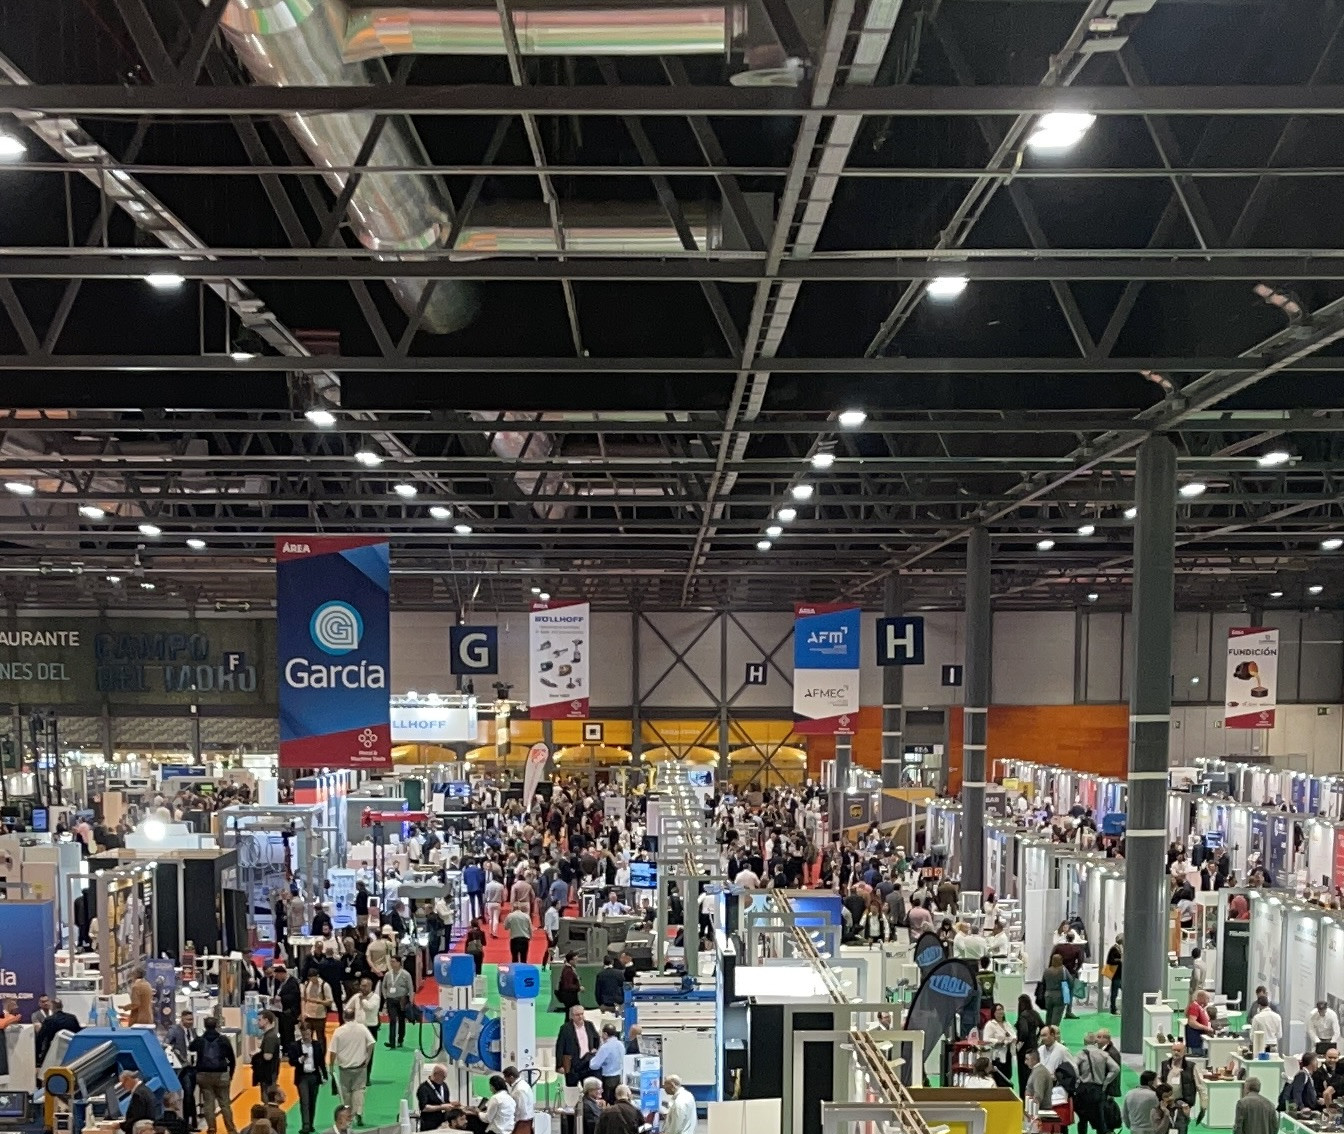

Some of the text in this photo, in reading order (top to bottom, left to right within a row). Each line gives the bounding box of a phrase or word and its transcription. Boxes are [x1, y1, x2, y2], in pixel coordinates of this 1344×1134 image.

[283, 542, 312, 554] ÁREA
[886, 624, 915, 659] H
[459, 633, 490, 669] G
[1228, 648, 1277, 657] FUNDICIÓN
[37, 663, 71, 681] DEL
[229, 655, 240, 672] F
[284, 657, 386, 689] García
[749, 666, 763, 682] H
